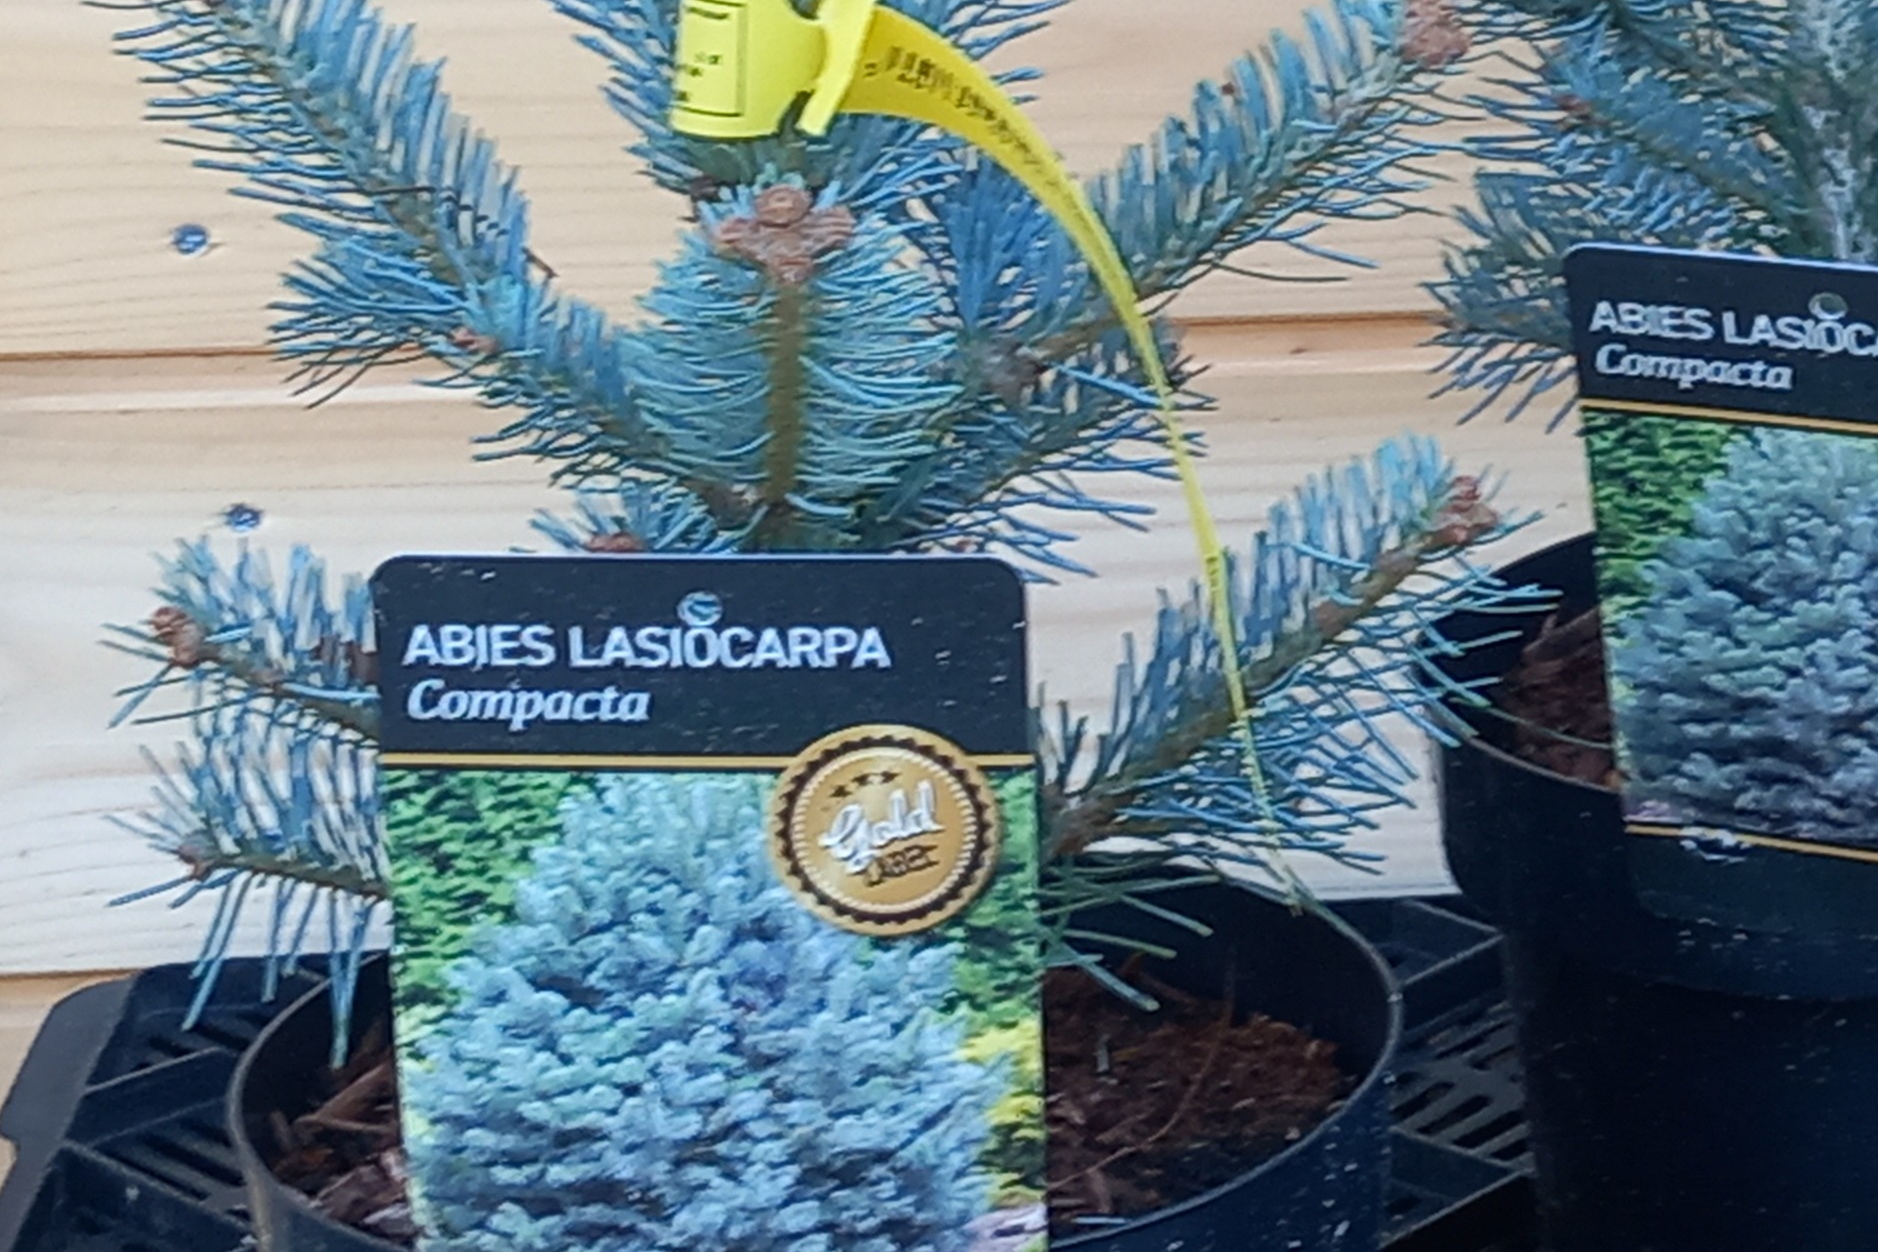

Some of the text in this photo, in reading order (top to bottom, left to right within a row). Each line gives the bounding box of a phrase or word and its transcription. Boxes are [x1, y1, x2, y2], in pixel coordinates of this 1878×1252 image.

[1589, 301, 1714, 340] ABIES
[1597, 344, 1793, 389] Compacta
[404, 624, 893, 669] ABIES LASIOCARPA
[406, 678, 651, 729] Compacta
[818, 779, 944, 875] Gold
